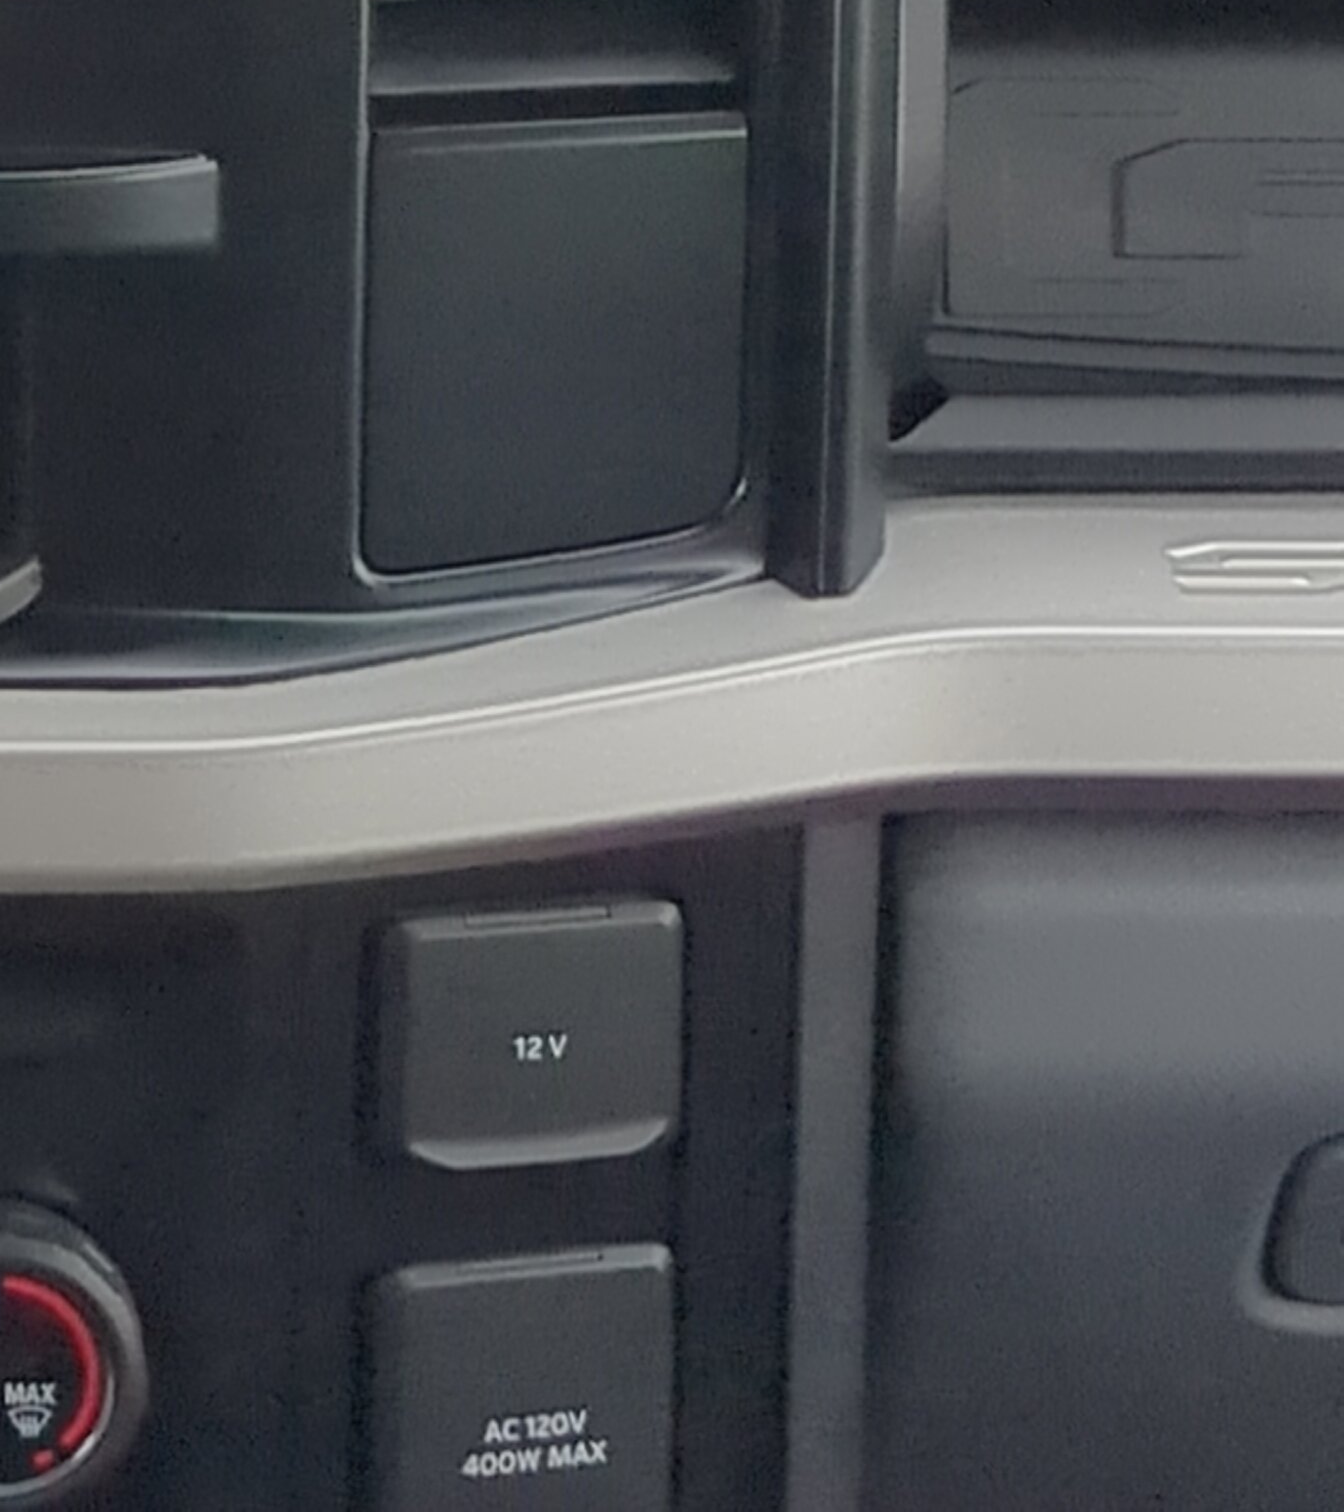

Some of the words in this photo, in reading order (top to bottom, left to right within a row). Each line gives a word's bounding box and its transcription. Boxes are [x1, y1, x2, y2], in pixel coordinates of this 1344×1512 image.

[513, 1035, 543, 1061] 12
[548, 1033, 568, 1059] V
[3, 1380, 57, 1406] MAX
[483, 1416, 521, 1444] AC
[524, 1407, 588, 1440] 120V
[461, 1444, 543, 1478] 400W
[546, 1438, 608, 1470] MAX
